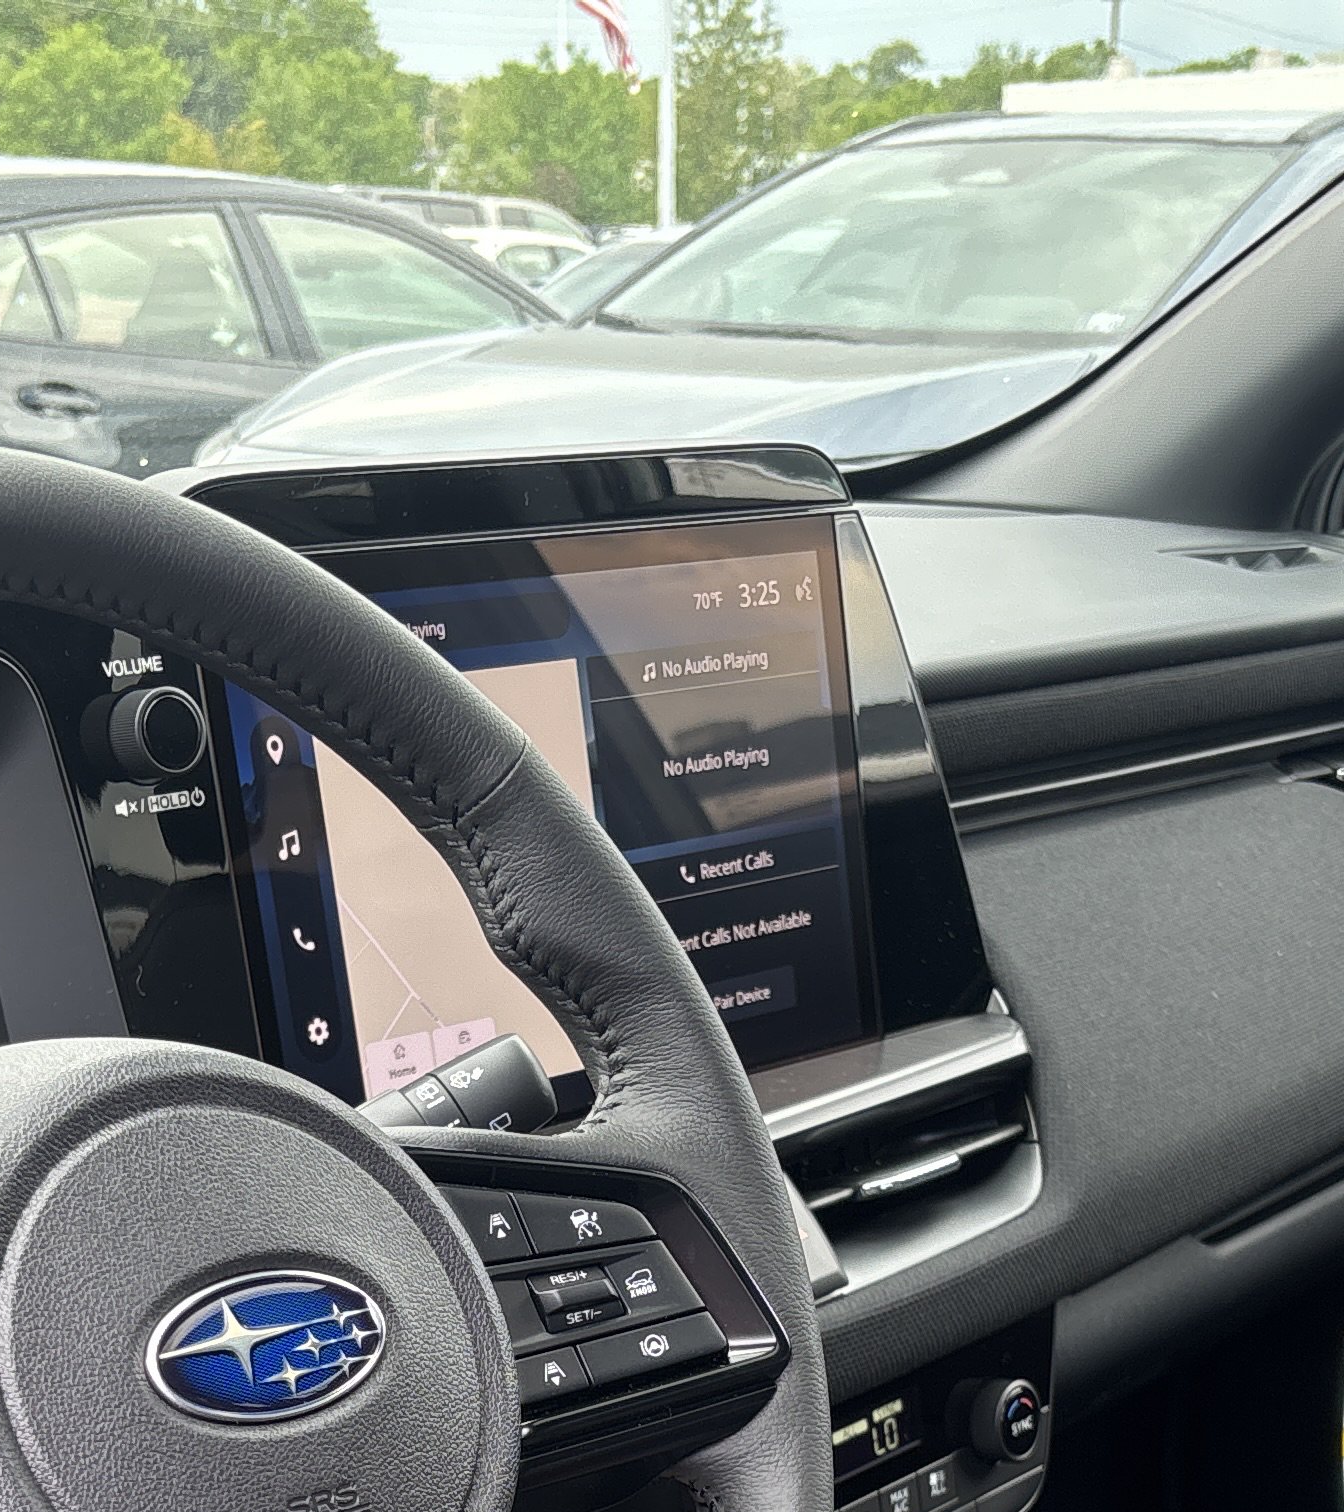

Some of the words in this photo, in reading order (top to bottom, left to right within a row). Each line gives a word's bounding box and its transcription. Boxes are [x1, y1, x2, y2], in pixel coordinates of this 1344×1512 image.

[738, 580, 781, 608] 3:25
[407, 621, 446, 641] laying
[102, 656, 164, 678] VOLUME
[662, 661, 683, 678] No
[684, 656, 722, 675] Audio
[723, 650, 769, 673] Playing
[663, 760, 684, 778] No
[685, 754, 723, 775] Audio
[724, 748, 770, 770] Playing
[149, 793, 190, 811] HOLD
[700, 859, 744, 880] Recent
[744, 851, 775, 871] Calls
[680, 935, 702, 951] ent
[701, 928, 732, 948] Calls
[732, 923, 757, 942] Not
[757, 910, 812, 936] Available
[713, 994, 735, 1010] Pair
[735, 986, 771, 1006] Device
